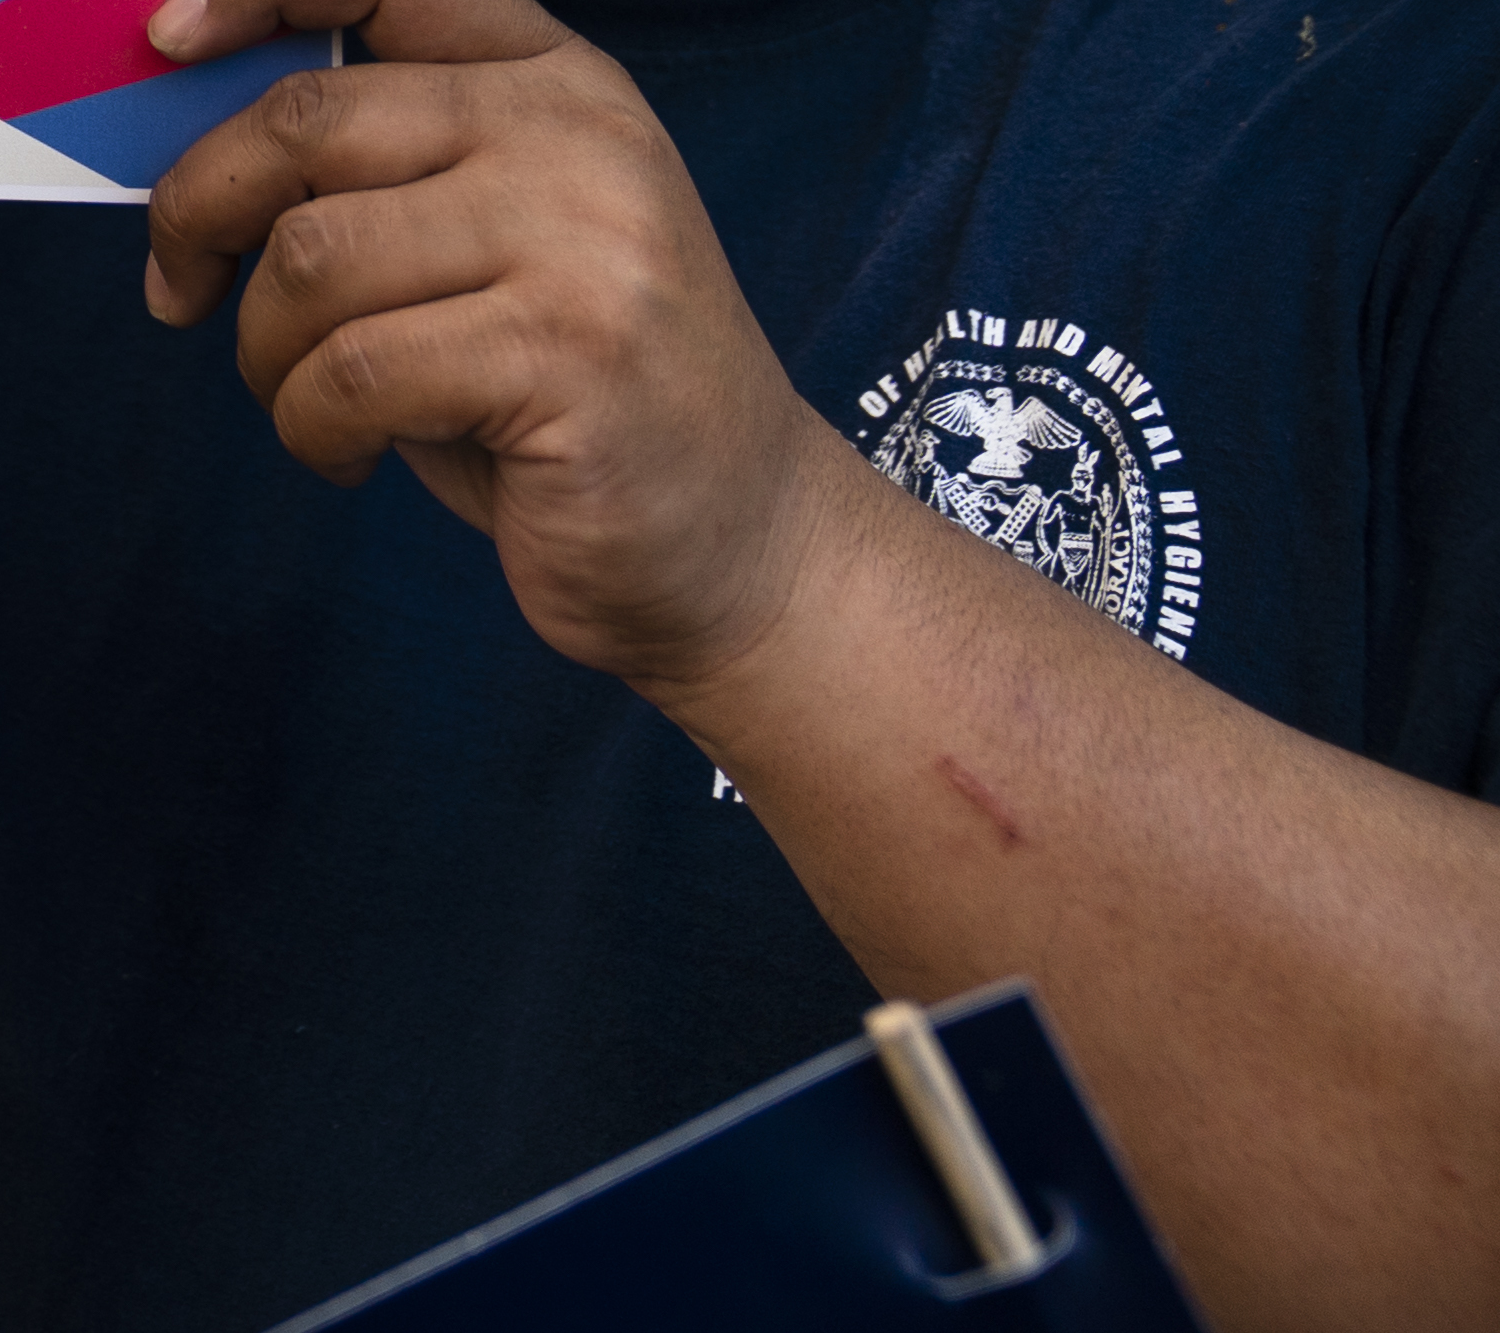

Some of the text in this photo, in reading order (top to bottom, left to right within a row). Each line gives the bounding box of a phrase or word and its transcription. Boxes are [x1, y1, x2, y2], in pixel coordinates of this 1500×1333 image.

[857, 373, 901, 419] OF
[1015, 318, 1086, 357] AND
[1086, 345, 1183, 471] MENTAL
[1152, 490, 1202, 661] HYGIENE
